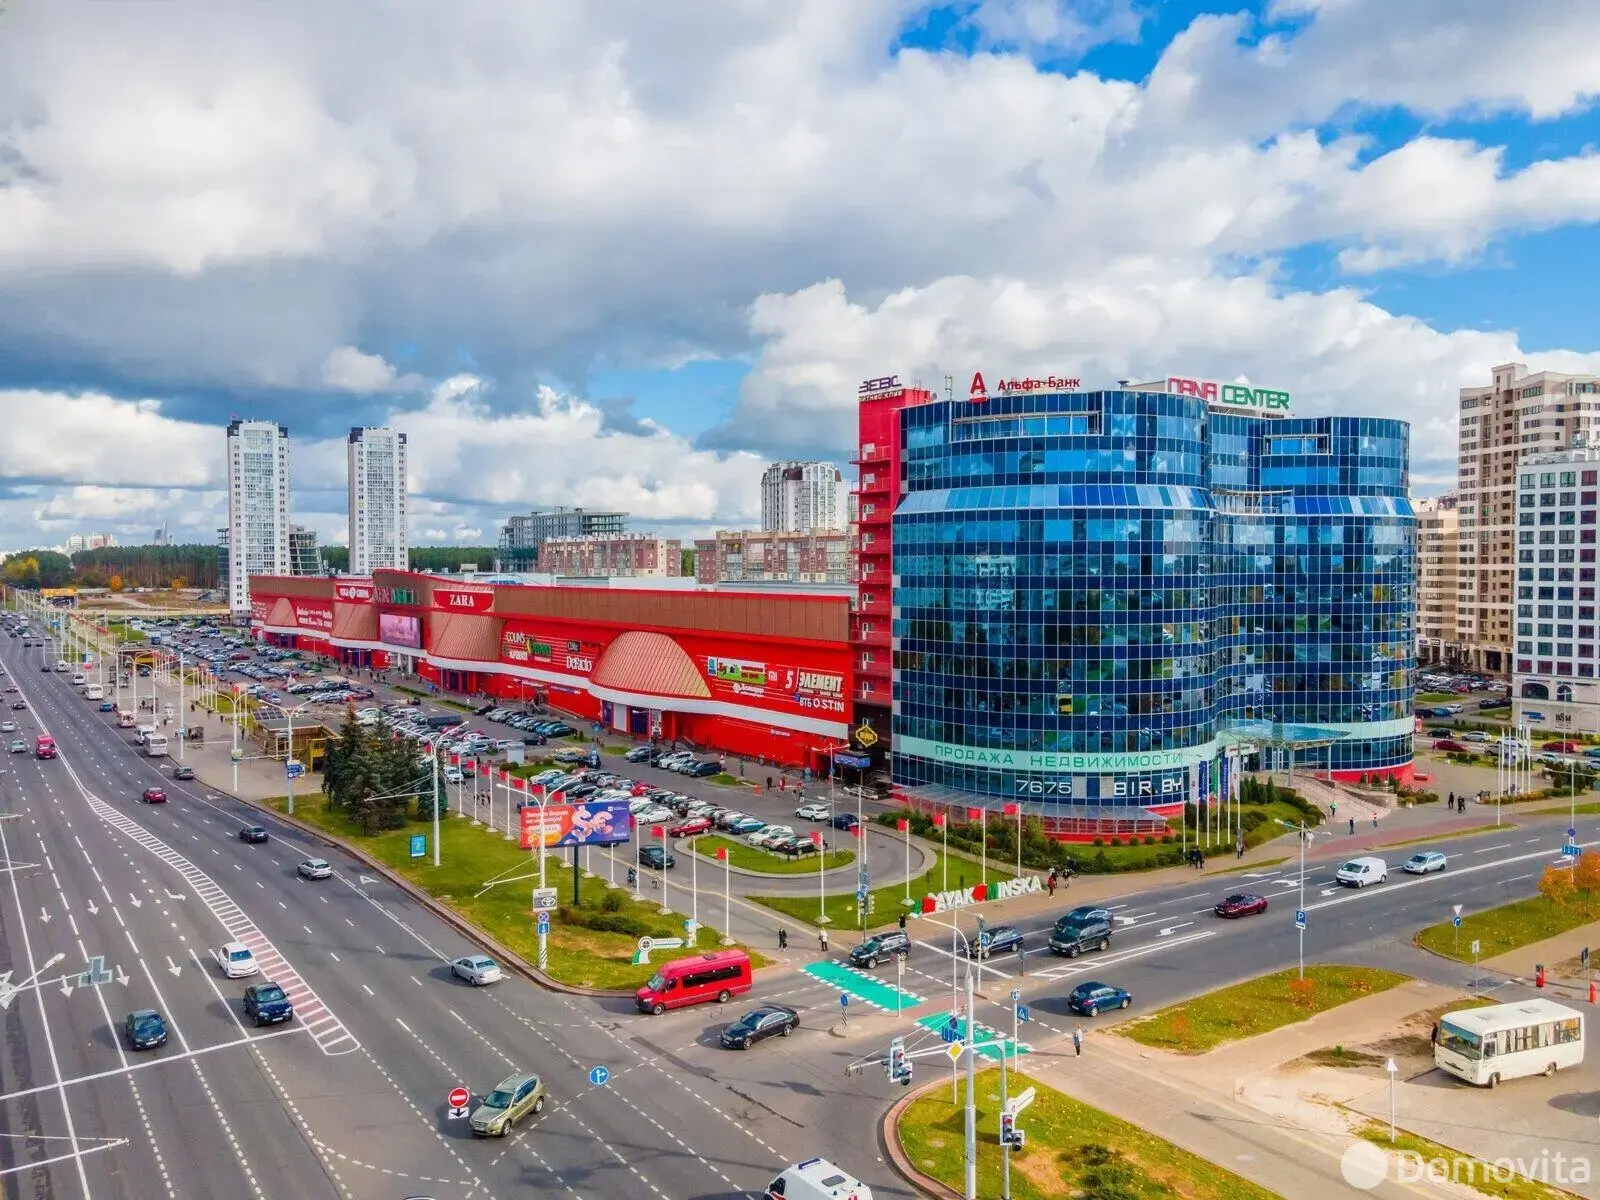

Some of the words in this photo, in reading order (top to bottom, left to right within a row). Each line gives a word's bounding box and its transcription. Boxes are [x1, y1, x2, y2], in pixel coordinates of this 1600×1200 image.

[858, 375, 902, 393] ЗЕВС
[998, 376, 1080, 392] Альфа-Банк
[1222, 384, 1290, 409] CENTER
[449, 594, 475, 607] ZARA
[785, 670, 794, 689] 5
[799, 671, 844, 692] ЭЛЕМЕНТ
[800, 698, 813, 708] ВТБ
[935, 744, 1014, 765] ПРОДАЖА
[1030, 753, 1182, 768] НЕДВИЖИМОСТИ
[1015, 779, 1072, 795] 7675
[1114, 777, 1182, 796] BIR.BY
